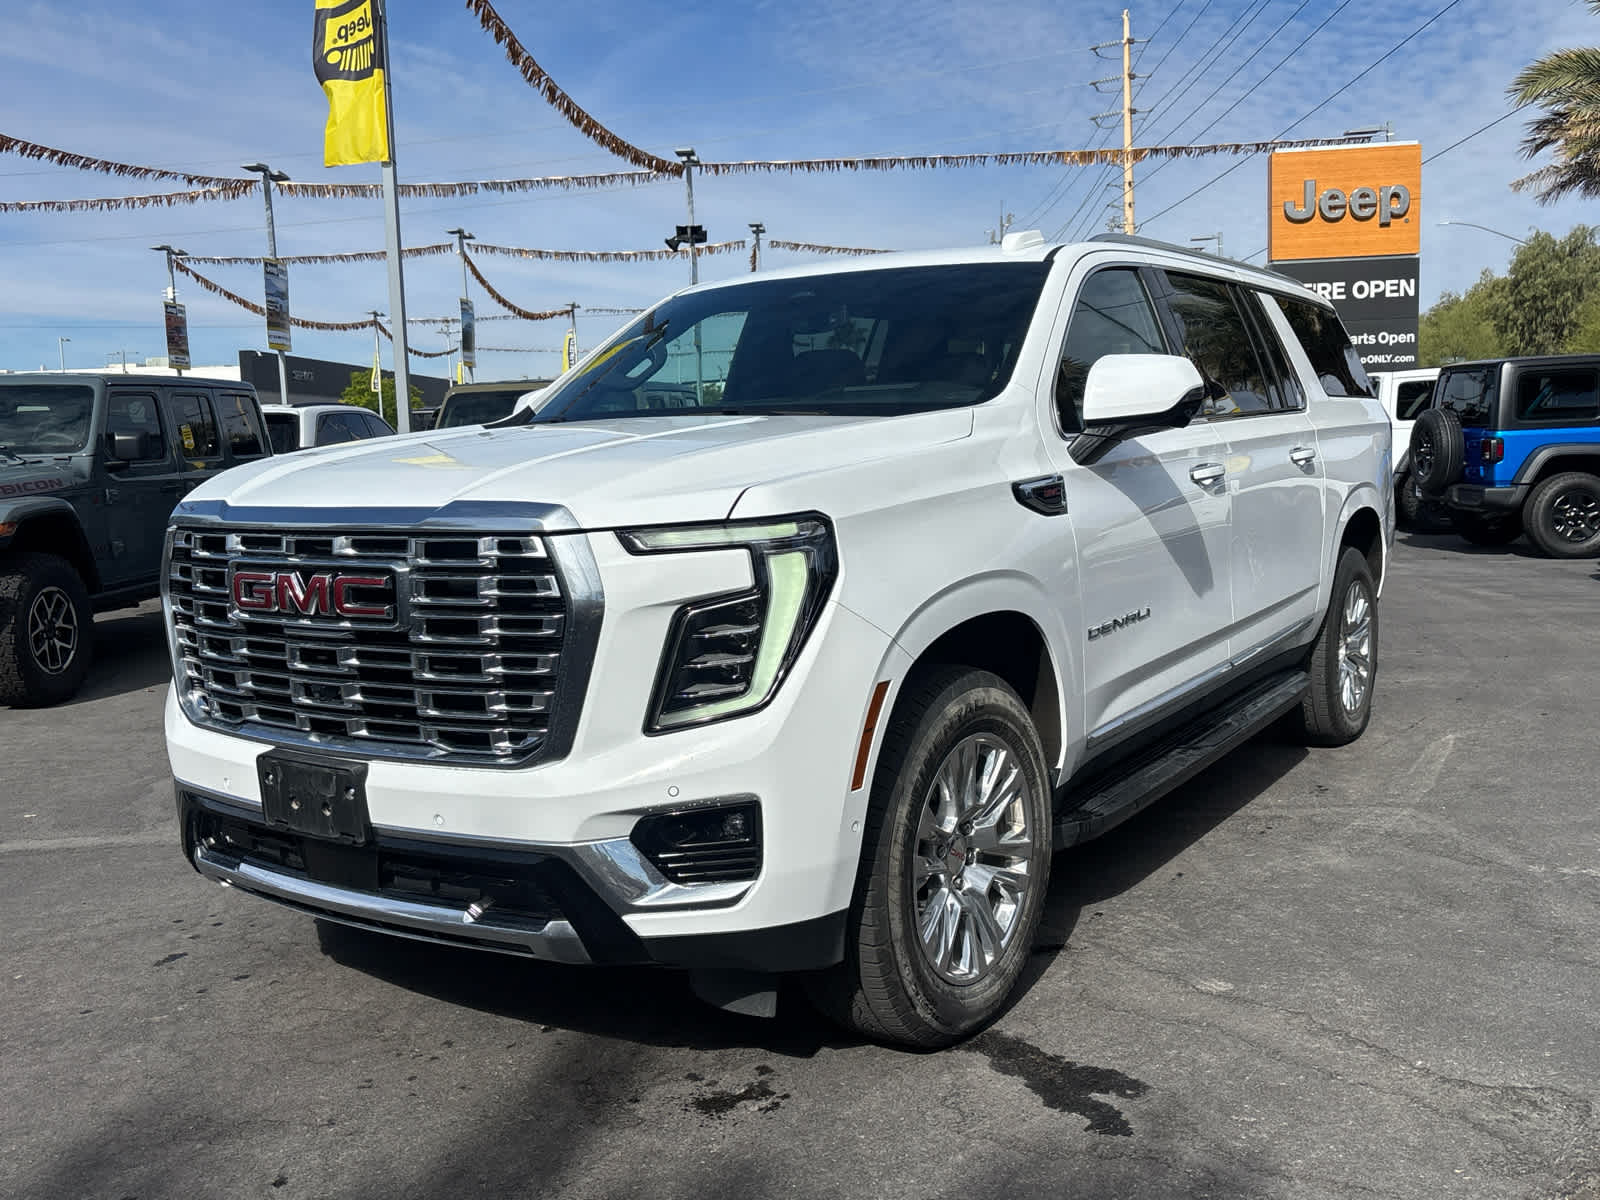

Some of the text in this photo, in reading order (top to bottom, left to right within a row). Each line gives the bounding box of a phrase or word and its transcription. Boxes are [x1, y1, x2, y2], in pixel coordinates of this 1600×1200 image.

[1284, 180, 1410, 227] Jeep
[1352, 278, 1415, 299] OPEN
[1378, 331, 1415, 346] Open
[233, 571, 393, 619] GMC
[1087, 607, 1151, 641] DENALI
